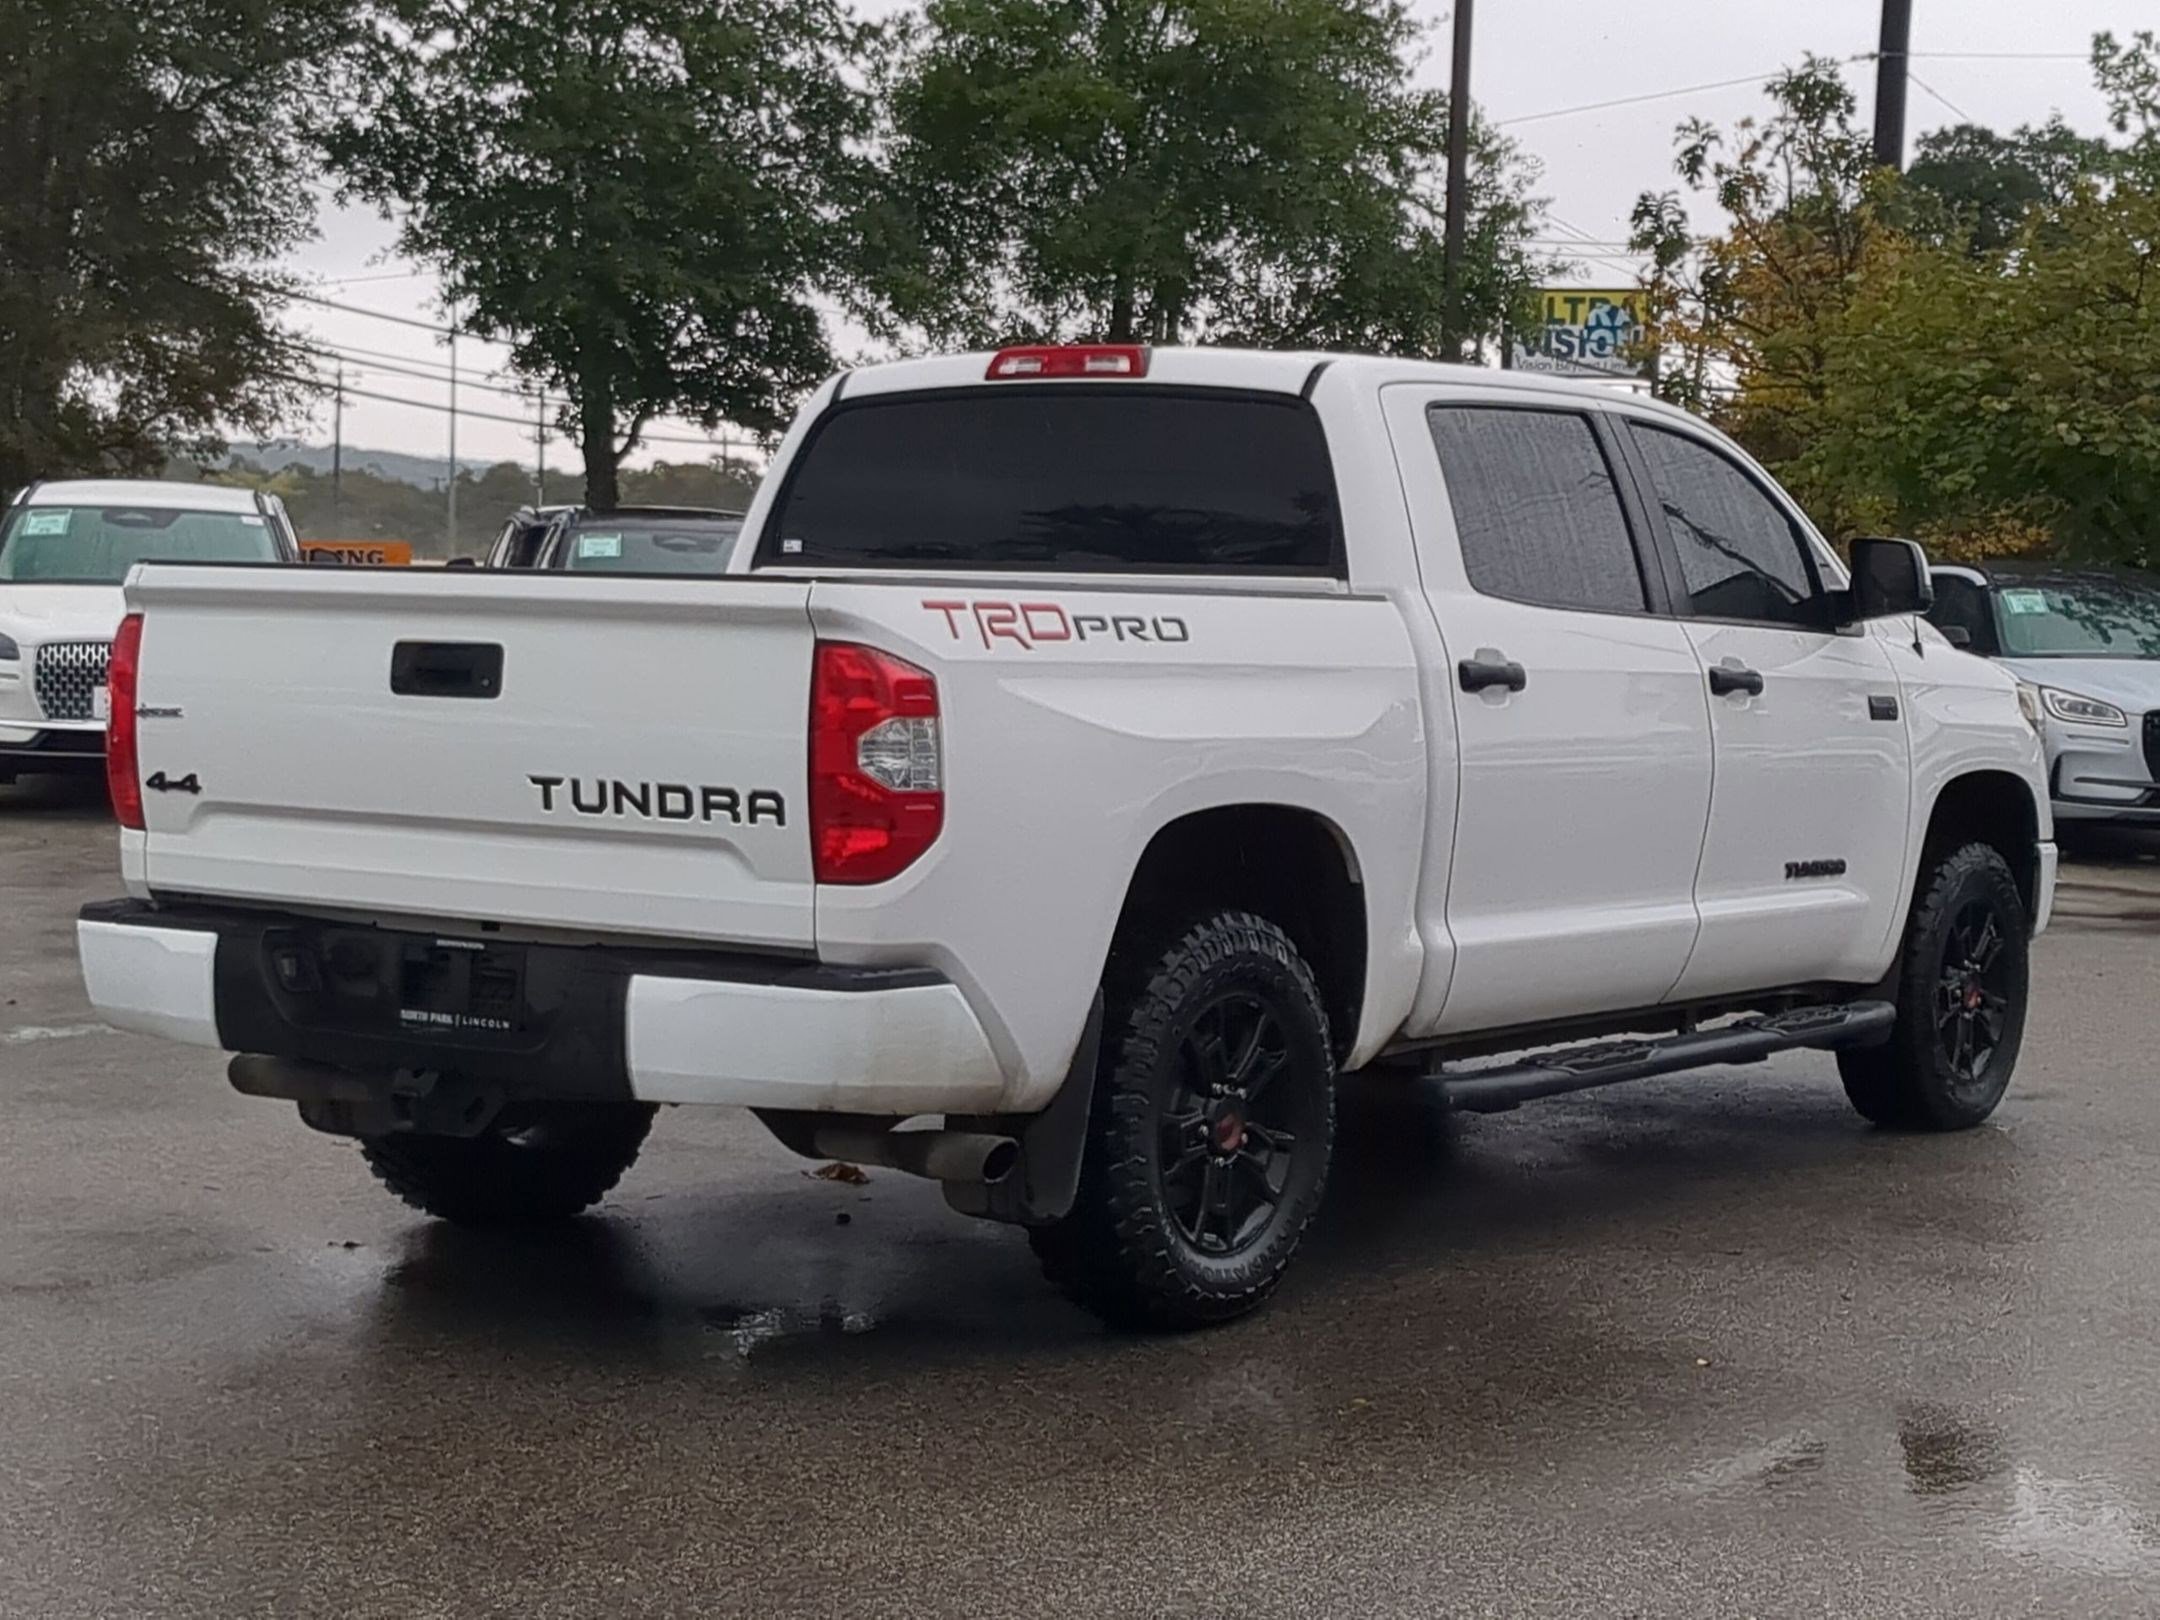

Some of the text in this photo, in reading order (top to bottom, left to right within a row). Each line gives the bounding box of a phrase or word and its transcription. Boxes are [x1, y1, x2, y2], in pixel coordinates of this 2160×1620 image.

[1546, 296, 1639, 326] LTRA
[1555, 357, 1599, 376] Beyod
[921, 601, 1189, 650] TRD PRO
[528, 775, 786, 827] TUNDRA
[462, 1016, 510, 1029] LINCOLN
